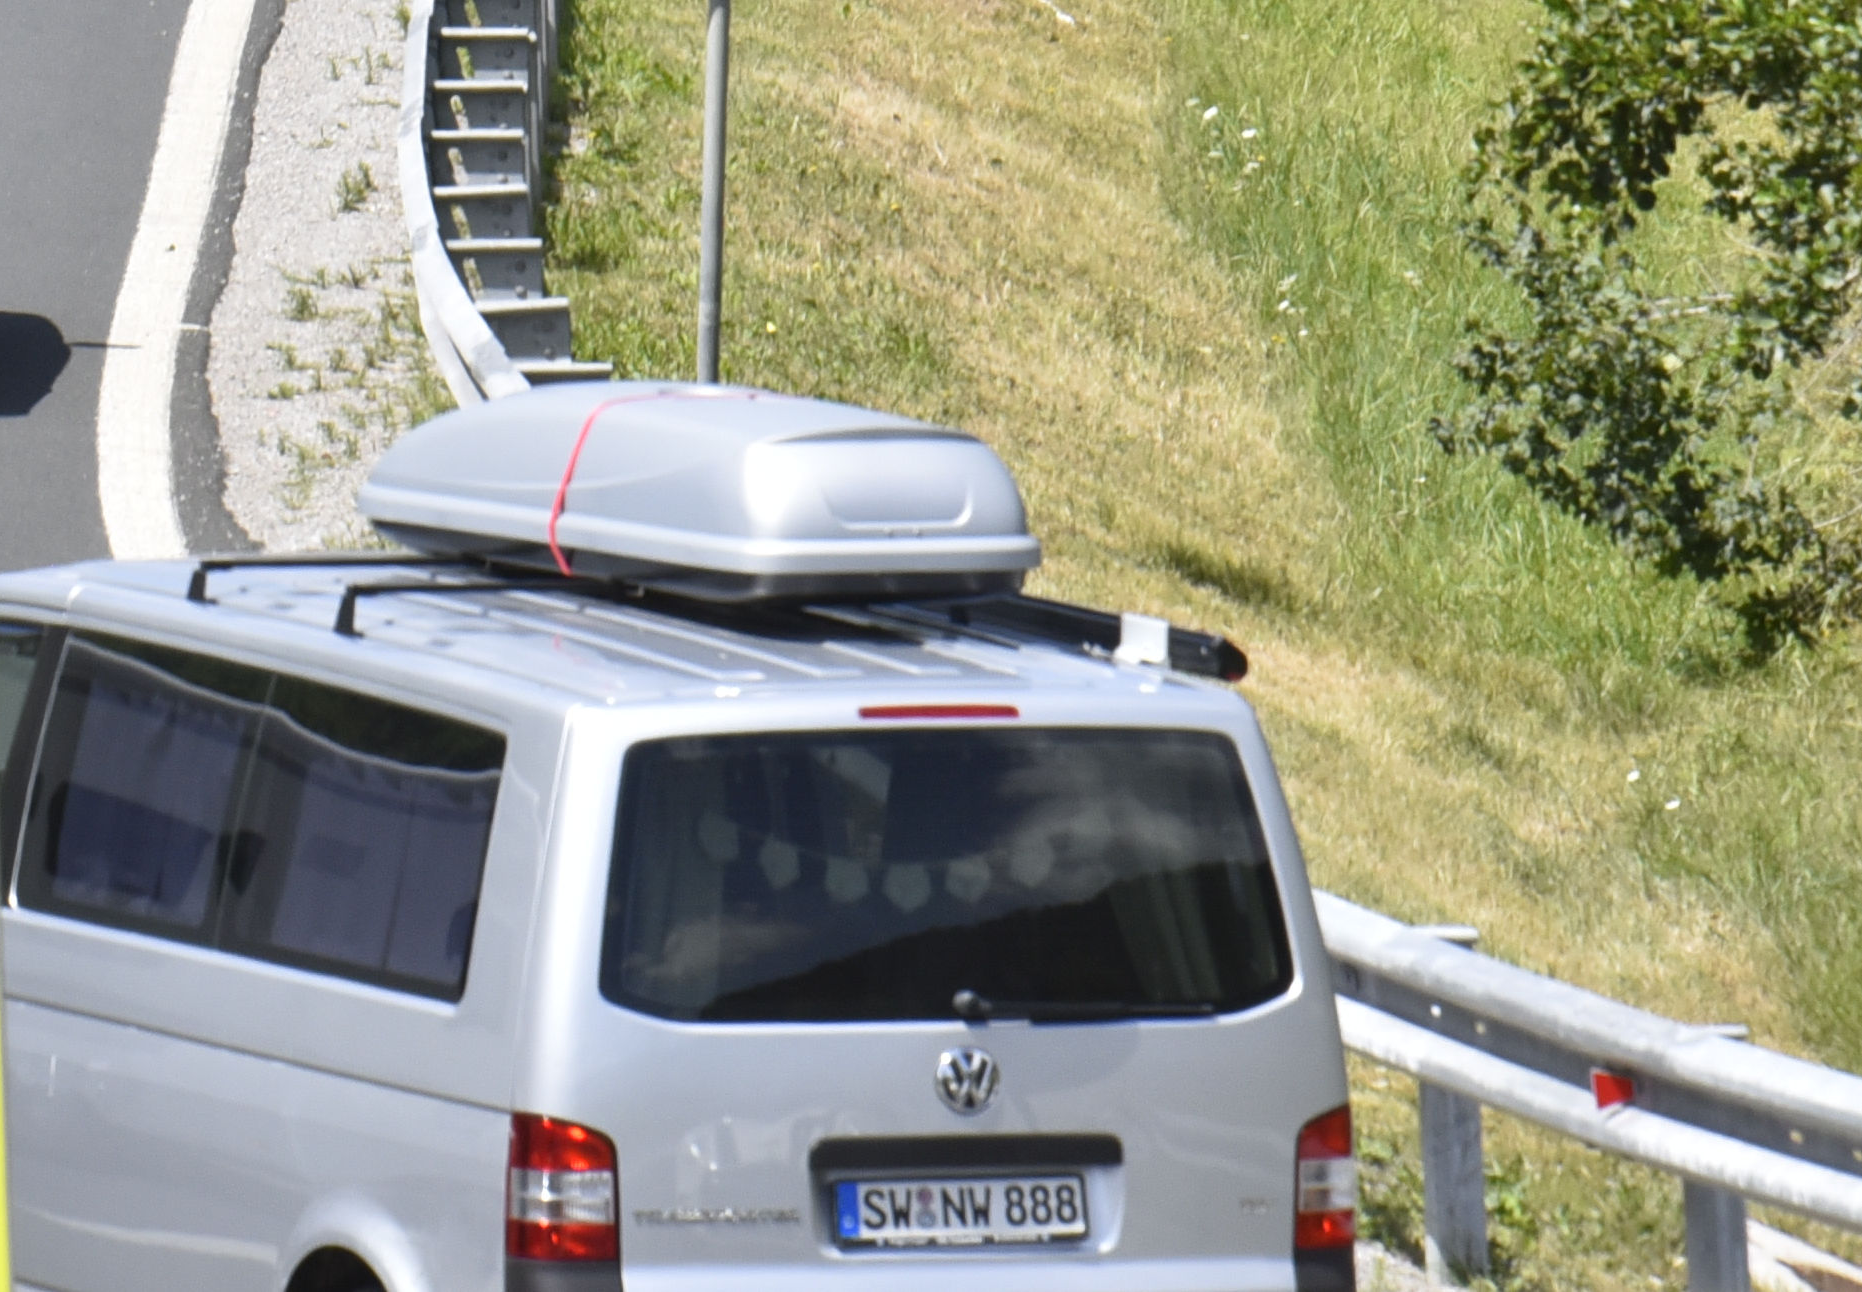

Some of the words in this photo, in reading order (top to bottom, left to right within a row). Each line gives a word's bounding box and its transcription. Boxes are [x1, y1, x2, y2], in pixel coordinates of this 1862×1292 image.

[862, 1188, 912, 1230] SW
[941, 1186, 992, 1227] NW
[1005, 1183, 1079, 1226] 888
